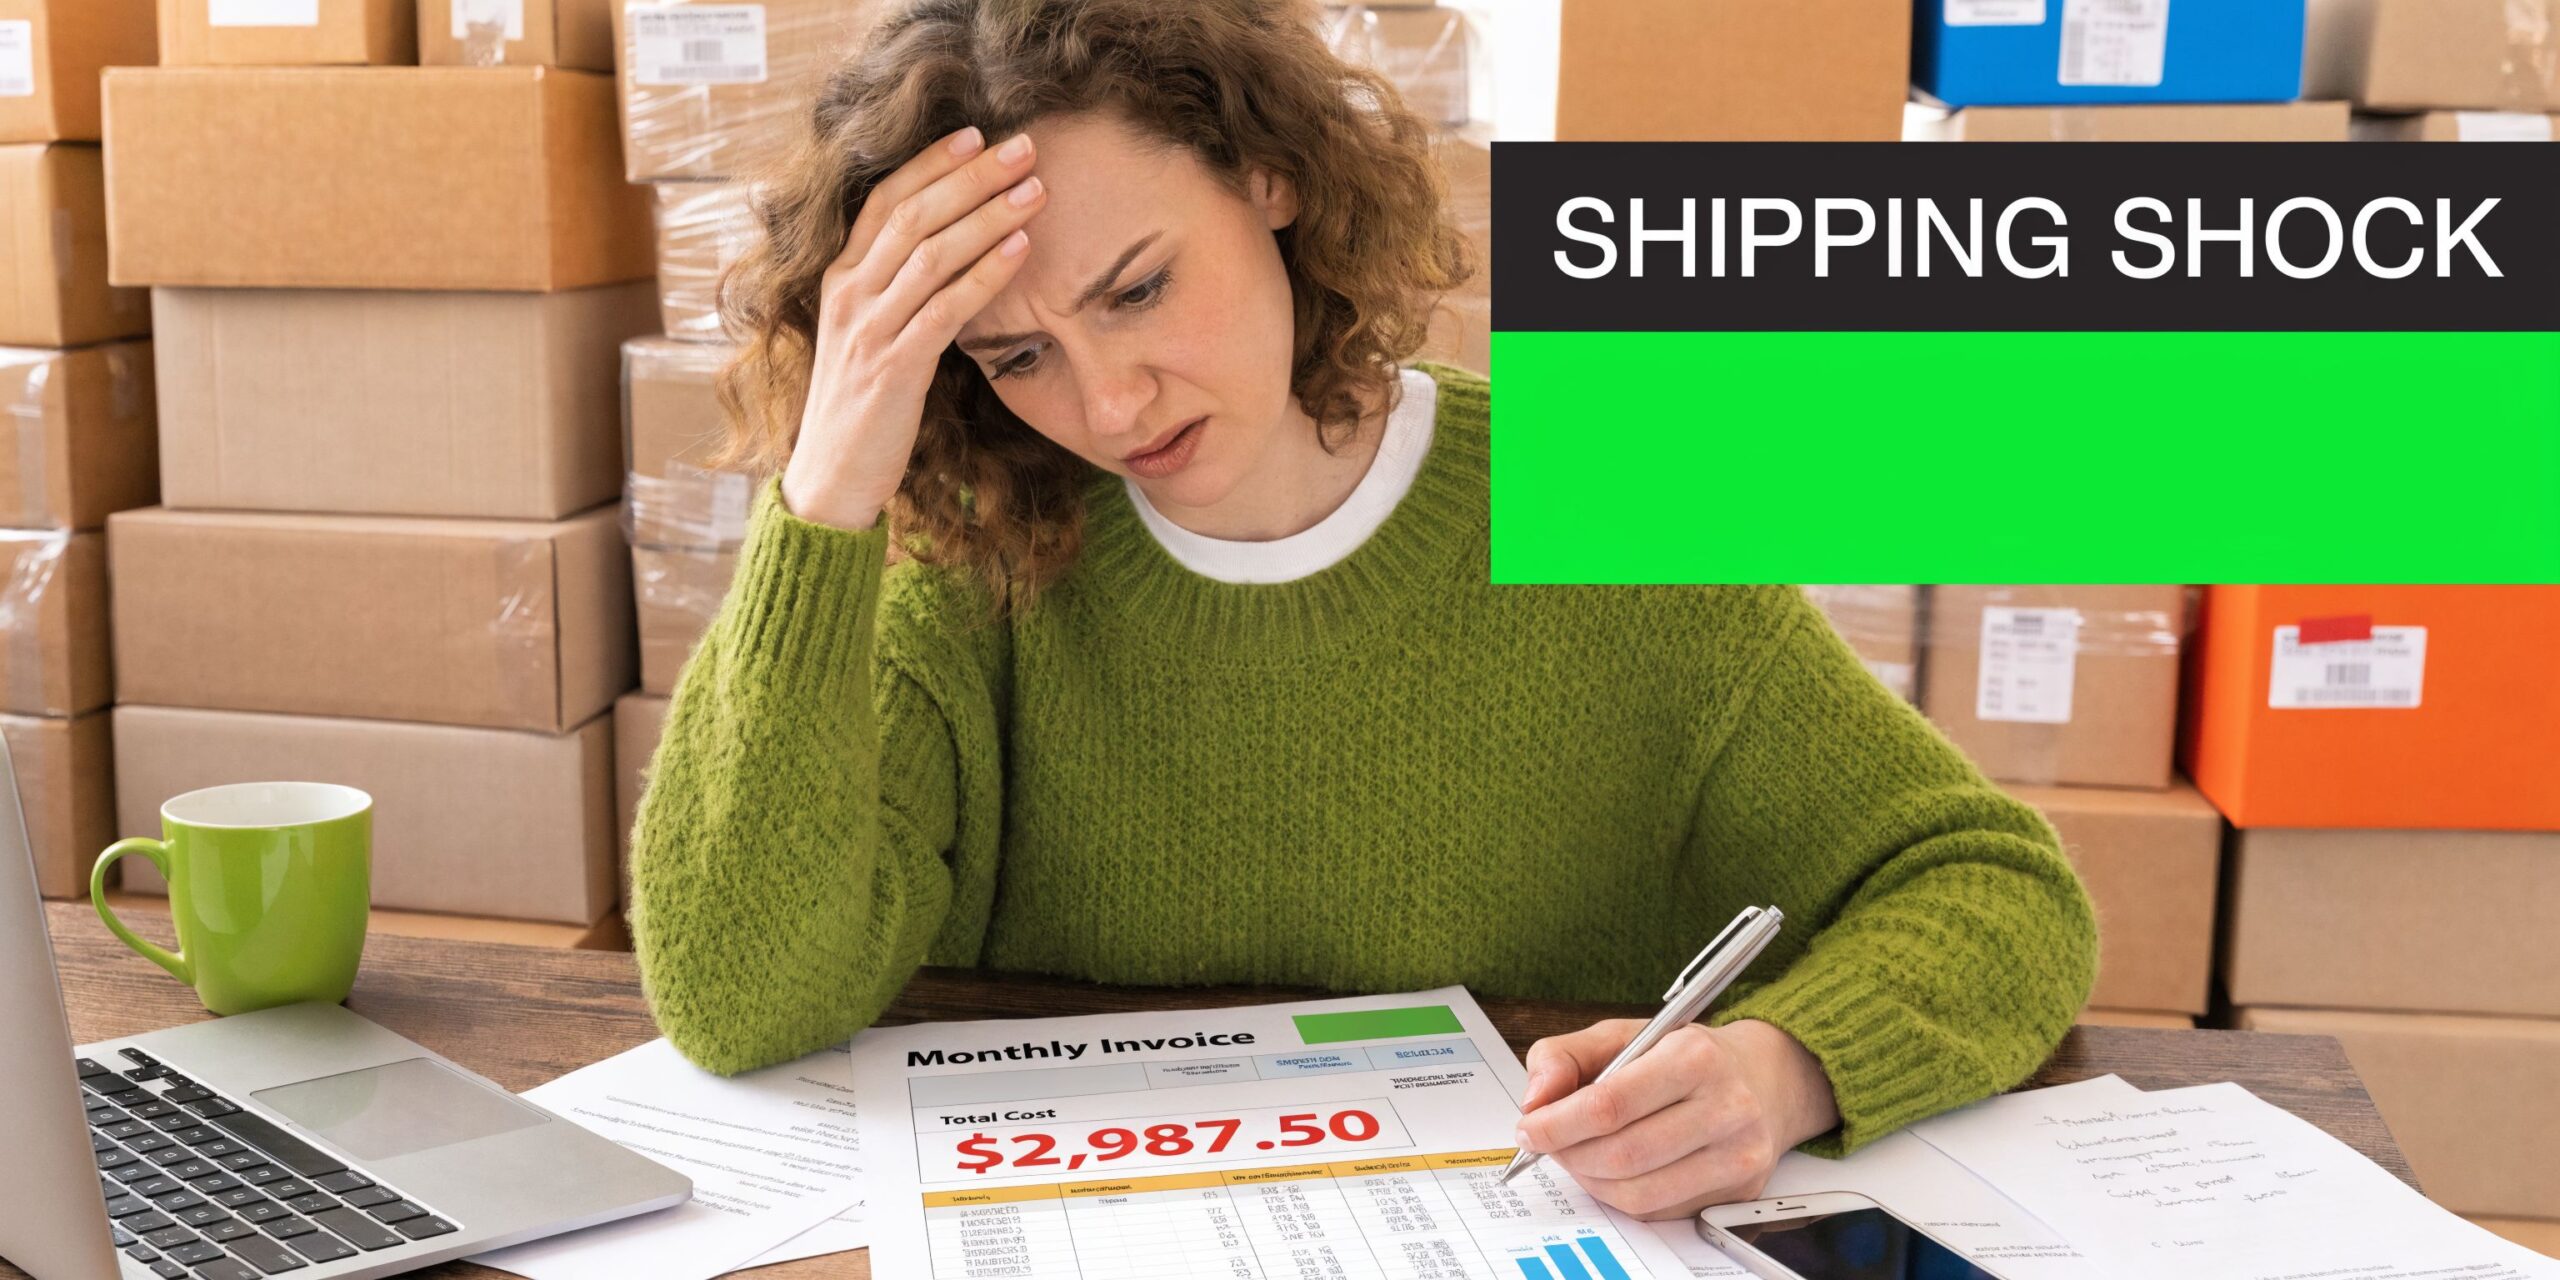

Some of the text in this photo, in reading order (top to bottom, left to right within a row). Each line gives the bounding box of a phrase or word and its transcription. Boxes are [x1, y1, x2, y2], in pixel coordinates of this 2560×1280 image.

[906, 1031, 1256, 1067] Monthly Invoice
[940, 1108, 1057, 1125] Total Cost
[956, 1109, 1381, 1175] $2,987.50
